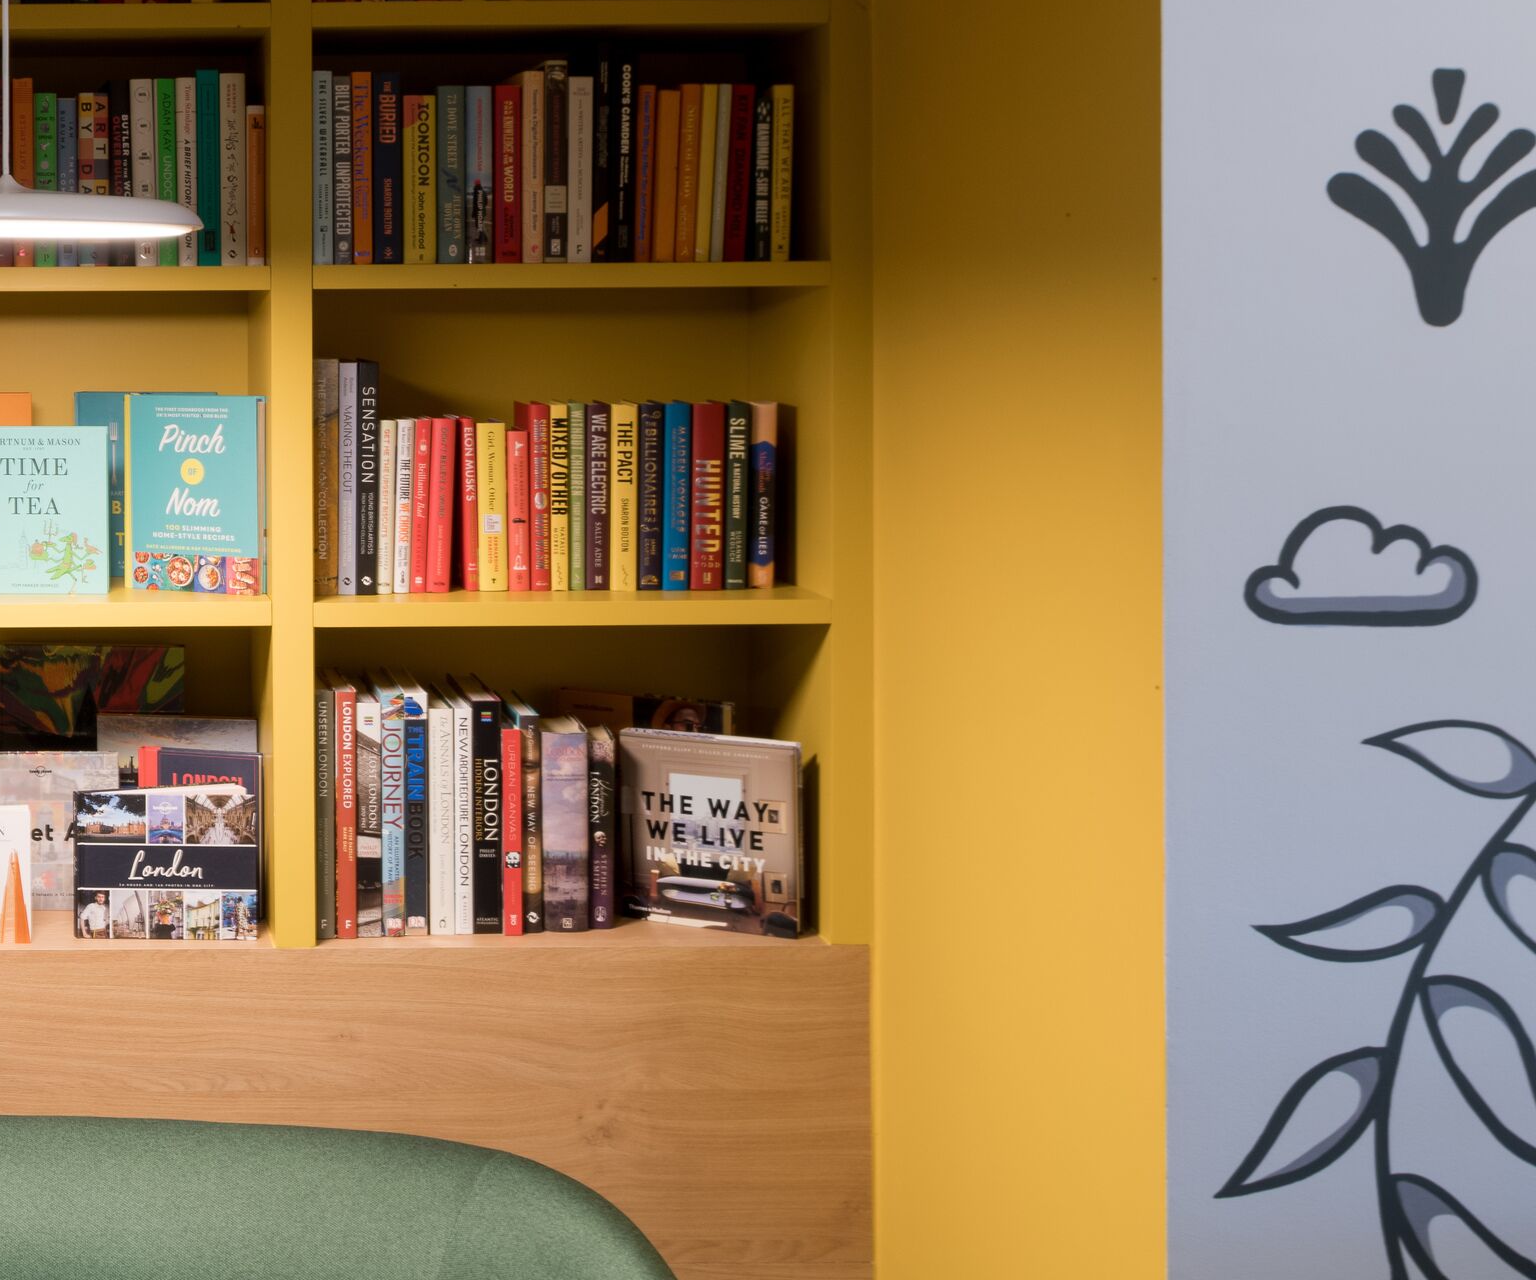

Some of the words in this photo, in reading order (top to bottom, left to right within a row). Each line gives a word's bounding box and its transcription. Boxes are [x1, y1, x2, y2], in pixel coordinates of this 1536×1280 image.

[336, 85, 349, 111] BILLY
[336, 116, 349, 154] PORTER
[379, 94, 396, 143] BURIED
[621, 107, 630, 153] CAMDEN
[418, 103, 429, 186] ICONICON
[336, 162, 350, 234] UNPROTECTED
[384, 177, 392, 206] SHARON
[418, 191, 426, 211] John
[384, 208, 392, 234] BOLTON
[418, 214, 426, 249] Grindrod
[159, 423, 226, 454] Pinch
[361, 387, 375, 483] SENSATION
[592, 414, 606, 433] WE
[617, 422, 632, 447] THE
[729, 418, 744, 459] SLIME
[464, 427, 474, 457] ELON
[592, 435, 606, 457] ARE
[0, 458, 68, 476] TIME
[400, 459, 410, 472] THE
[618, 451, 632, 484] PACT
[23, 480, 44, 493] for
[166, 487, 221, 517] Nom
[400, 473, 410, 500] FUTURE
[591, 461, 606, 515] ELECTRIC
[8, 497, 61, 515] TEA
[400, 503, 409, 513] WE
[695, 459, 720, 552] HUNTED
[399, 515, 408, 543] CHOOSE
[319, 702, 328, 745] UNSEEN
[343, 701, 352, 750] LONDON
[459, 717, 468, 752] NEW
[319, 749, 328, 797] LONDON
[343, 754, 352, 808] EXPLORED
[382, 724, 402, 830] JOURNEY
[407, 736, 424, 800] TRAIN
[475, 758, 483, 794] HIDDEN
[459, 754, 468, 822] ARCHITECTURE
[484, 759, 498, 840] LONDON
[527, 785, 536, 808] NEW
[475, 796, 483, 841] INTERIORS
[528, 812, 536, 832] WAY
[642, 791, 693, 815] THE
[707, 798, 768, 822] WAY
[408, 803, 423, 860] BOOK
[646, 820, 686, 843] WE
[702, 826, 763, 850] LIVE
[128, 849, 203, 880] London
[459, 825, 469, 886] LONDON
[528, 854, 536, 891] SEEING
[646, 846, 666, 860] IN
[673, 849, 712, 868] THE
[719, 855, 766, 873] CITY
